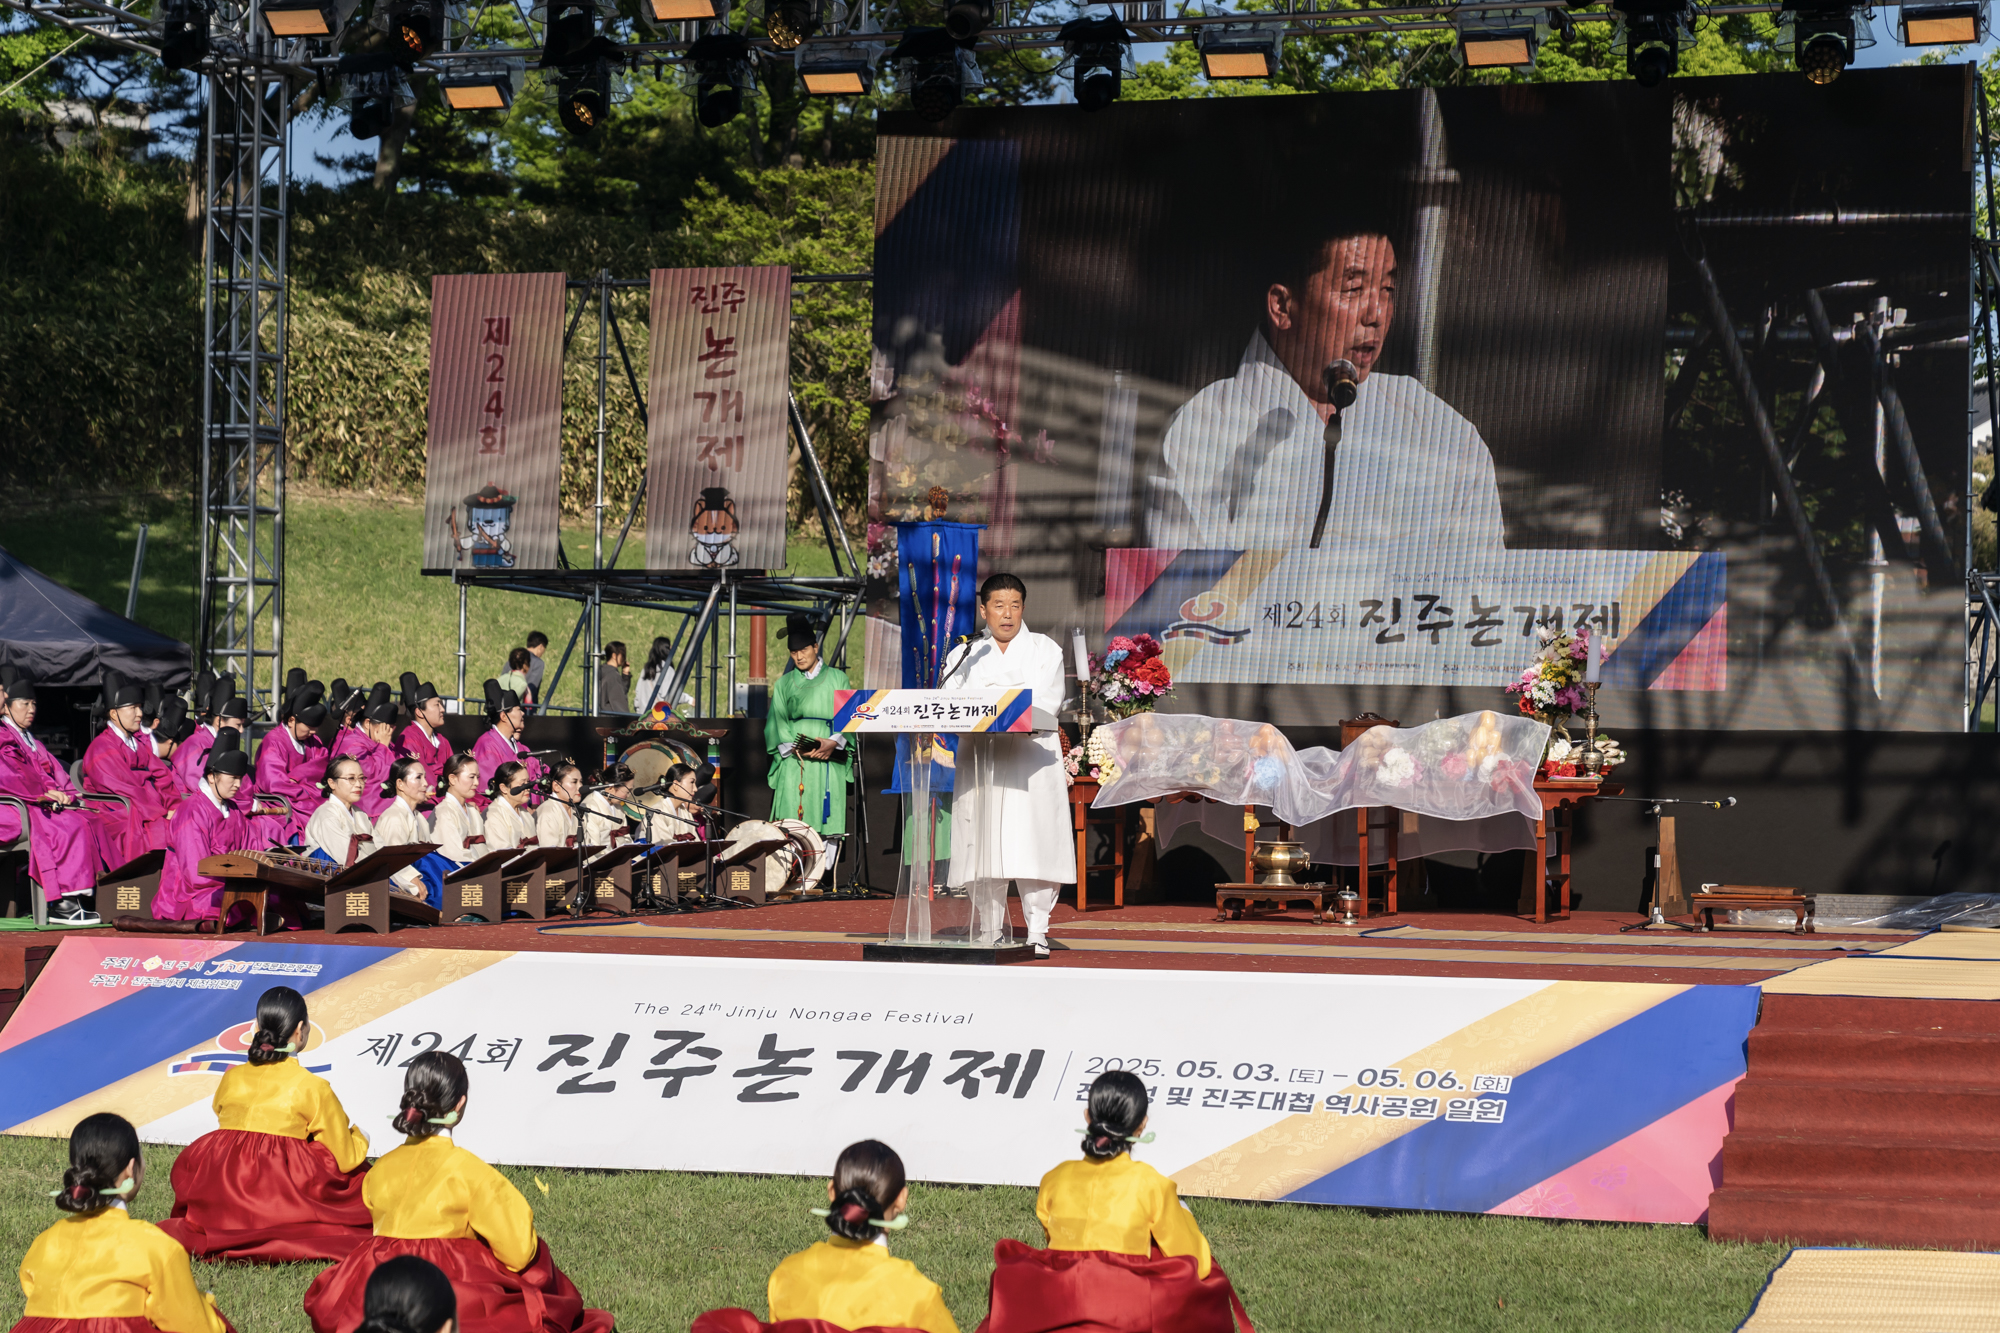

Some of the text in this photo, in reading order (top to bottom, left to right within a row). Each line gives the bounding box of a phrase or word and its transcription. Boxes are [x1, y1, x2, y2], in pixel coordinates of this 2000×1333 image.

[690, 282, 746, 314] 진주
[478, 316, 511, 457] 제24회
[693, 326, 744, 473] 논개제
[1262, 594, 1620, 647] 제24회 진주논개제
[882, 703, 997, 720] 제24회 진주논개제
[634, 1002, 974, 1025] The 24th Jinju Nongae Festival
[536, 1029, 1046, 1103] 진주논개제
[1176, 1060, 1223, 1079] 05.
[1232, 1063, 1280, 1082] 03.
[1357, 1068, 1406, 1088] 05.
[1415, 1070, 1464, 1090] 06.
[1166, 1086, 1194, 1106] 및
[1202, 1088, 1316, 1113] 진주대첩
[1325, 1094, 1439, 1119] 역사공원
[1447, 1099, 1505, 1122] 일원
